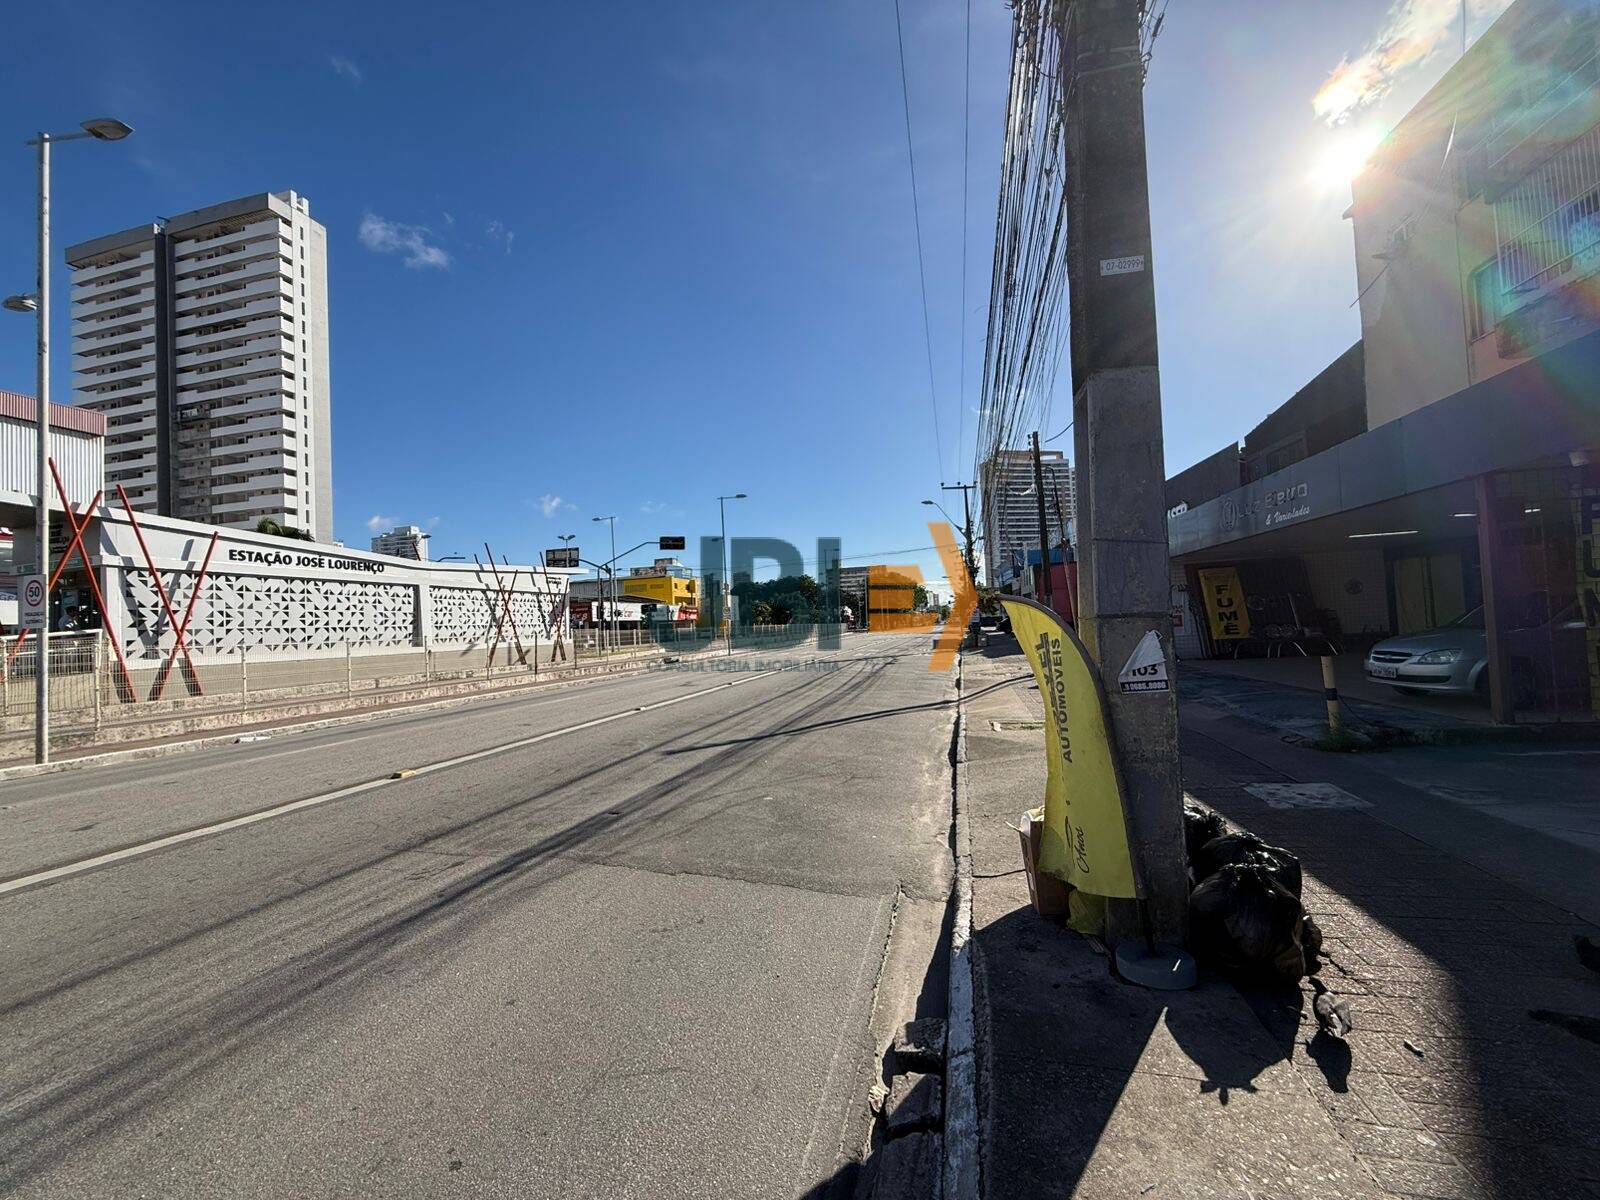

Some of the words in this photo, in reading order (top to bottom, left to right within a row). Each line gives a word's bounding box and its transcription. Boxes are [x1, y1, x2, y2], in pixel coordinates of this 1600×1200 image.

[229, 549, 293, 566] ESTAÇÃO
[295, 555, 325, 568] JOSÉ
[328, 559, 385, 574] LOURENÇO
[28, 586, 40, 598] 50
